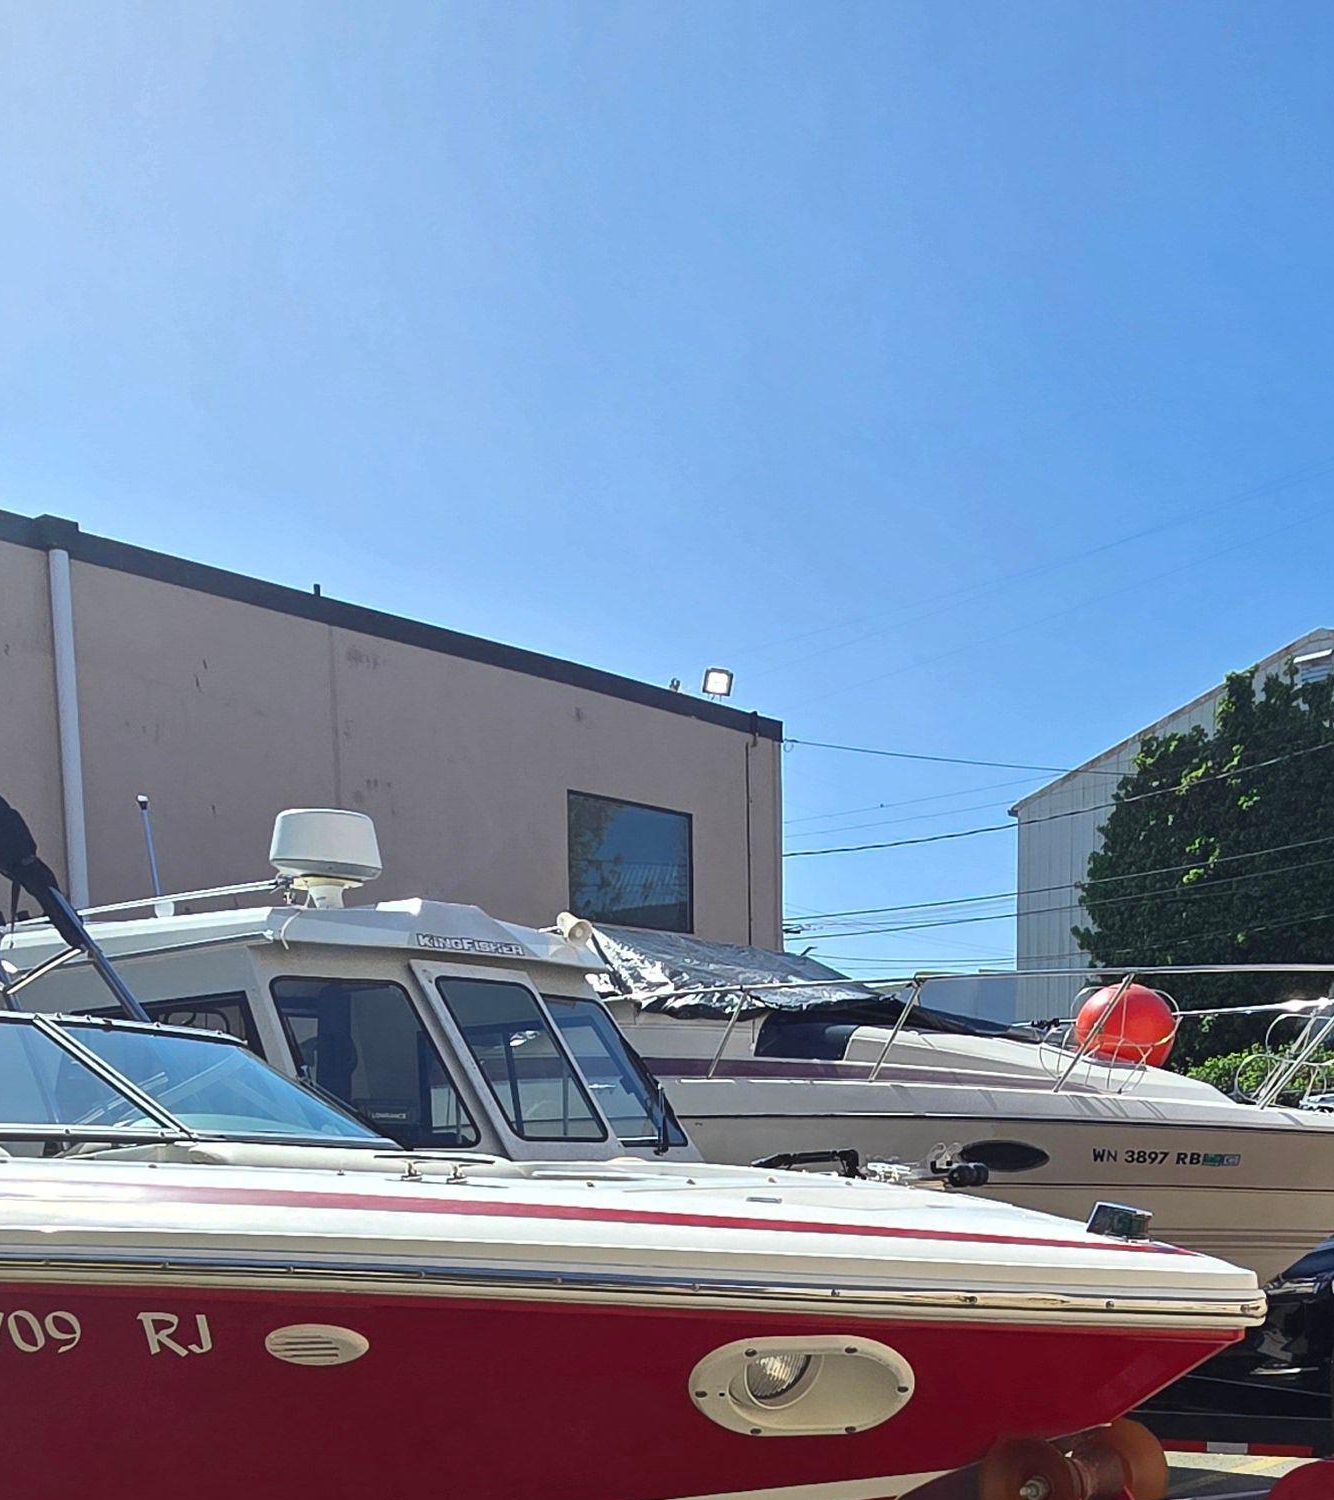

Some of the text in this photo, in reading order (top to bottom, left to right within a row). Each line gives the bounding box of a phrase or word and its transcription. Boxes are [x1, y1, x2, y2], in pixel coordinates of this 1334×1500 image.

[1092, 1149, 1117, 1163] WN
[1124, 1150, 1169, 1165] 3897
[1175, 1152, 1201, 1166] RB
[136, 1312, 213, 1357] RJ
